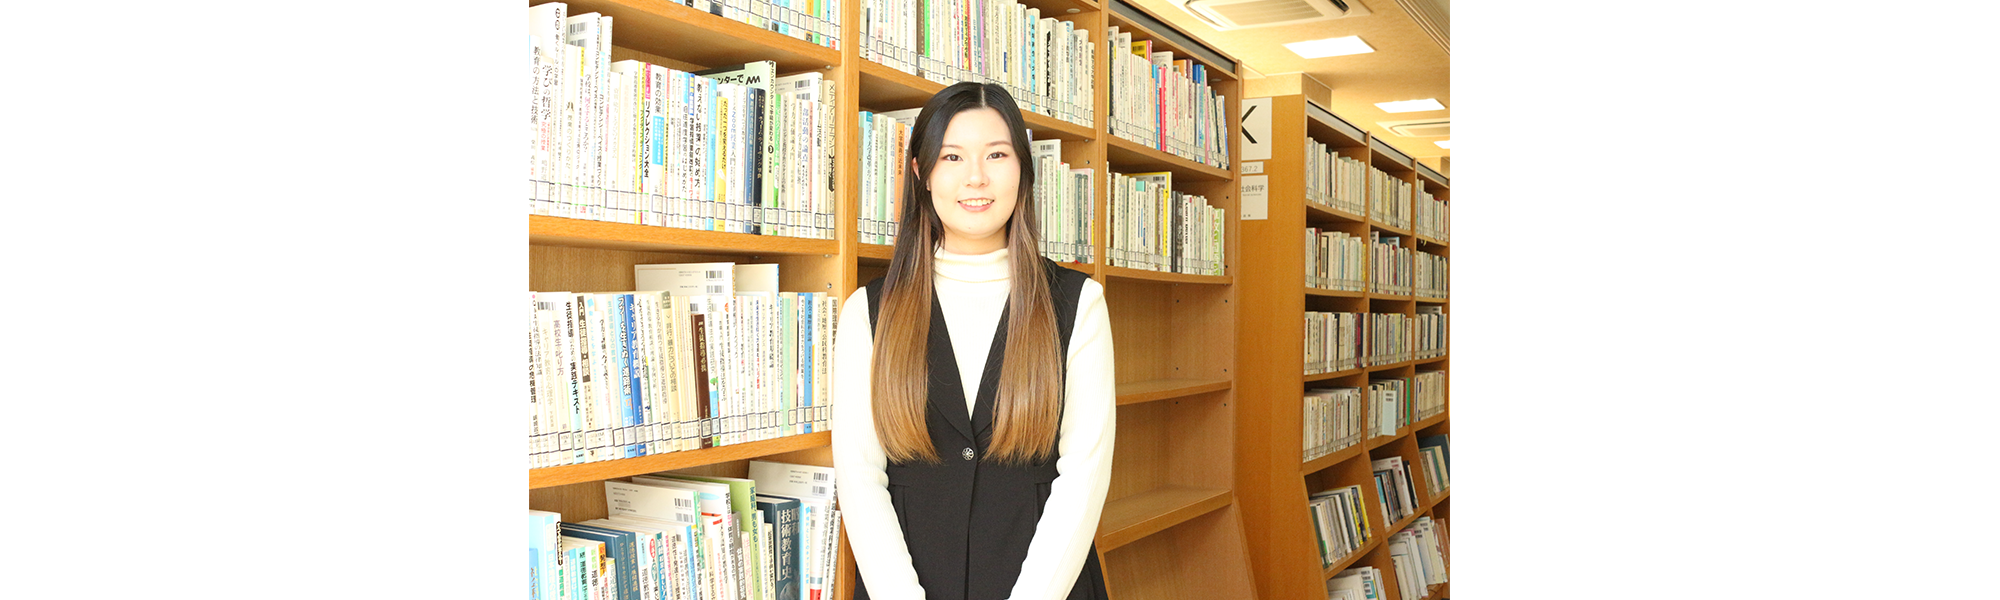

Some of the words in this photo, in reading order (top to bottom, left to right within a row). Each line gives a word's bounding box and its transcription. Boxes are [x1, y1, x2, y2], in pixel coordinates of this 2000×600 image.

[531, 46, 540, 124] 教育の方法と技術
[541, 65, 552, 120] 学びの哲学
[781, 509, 791, 580] 技術教育史
